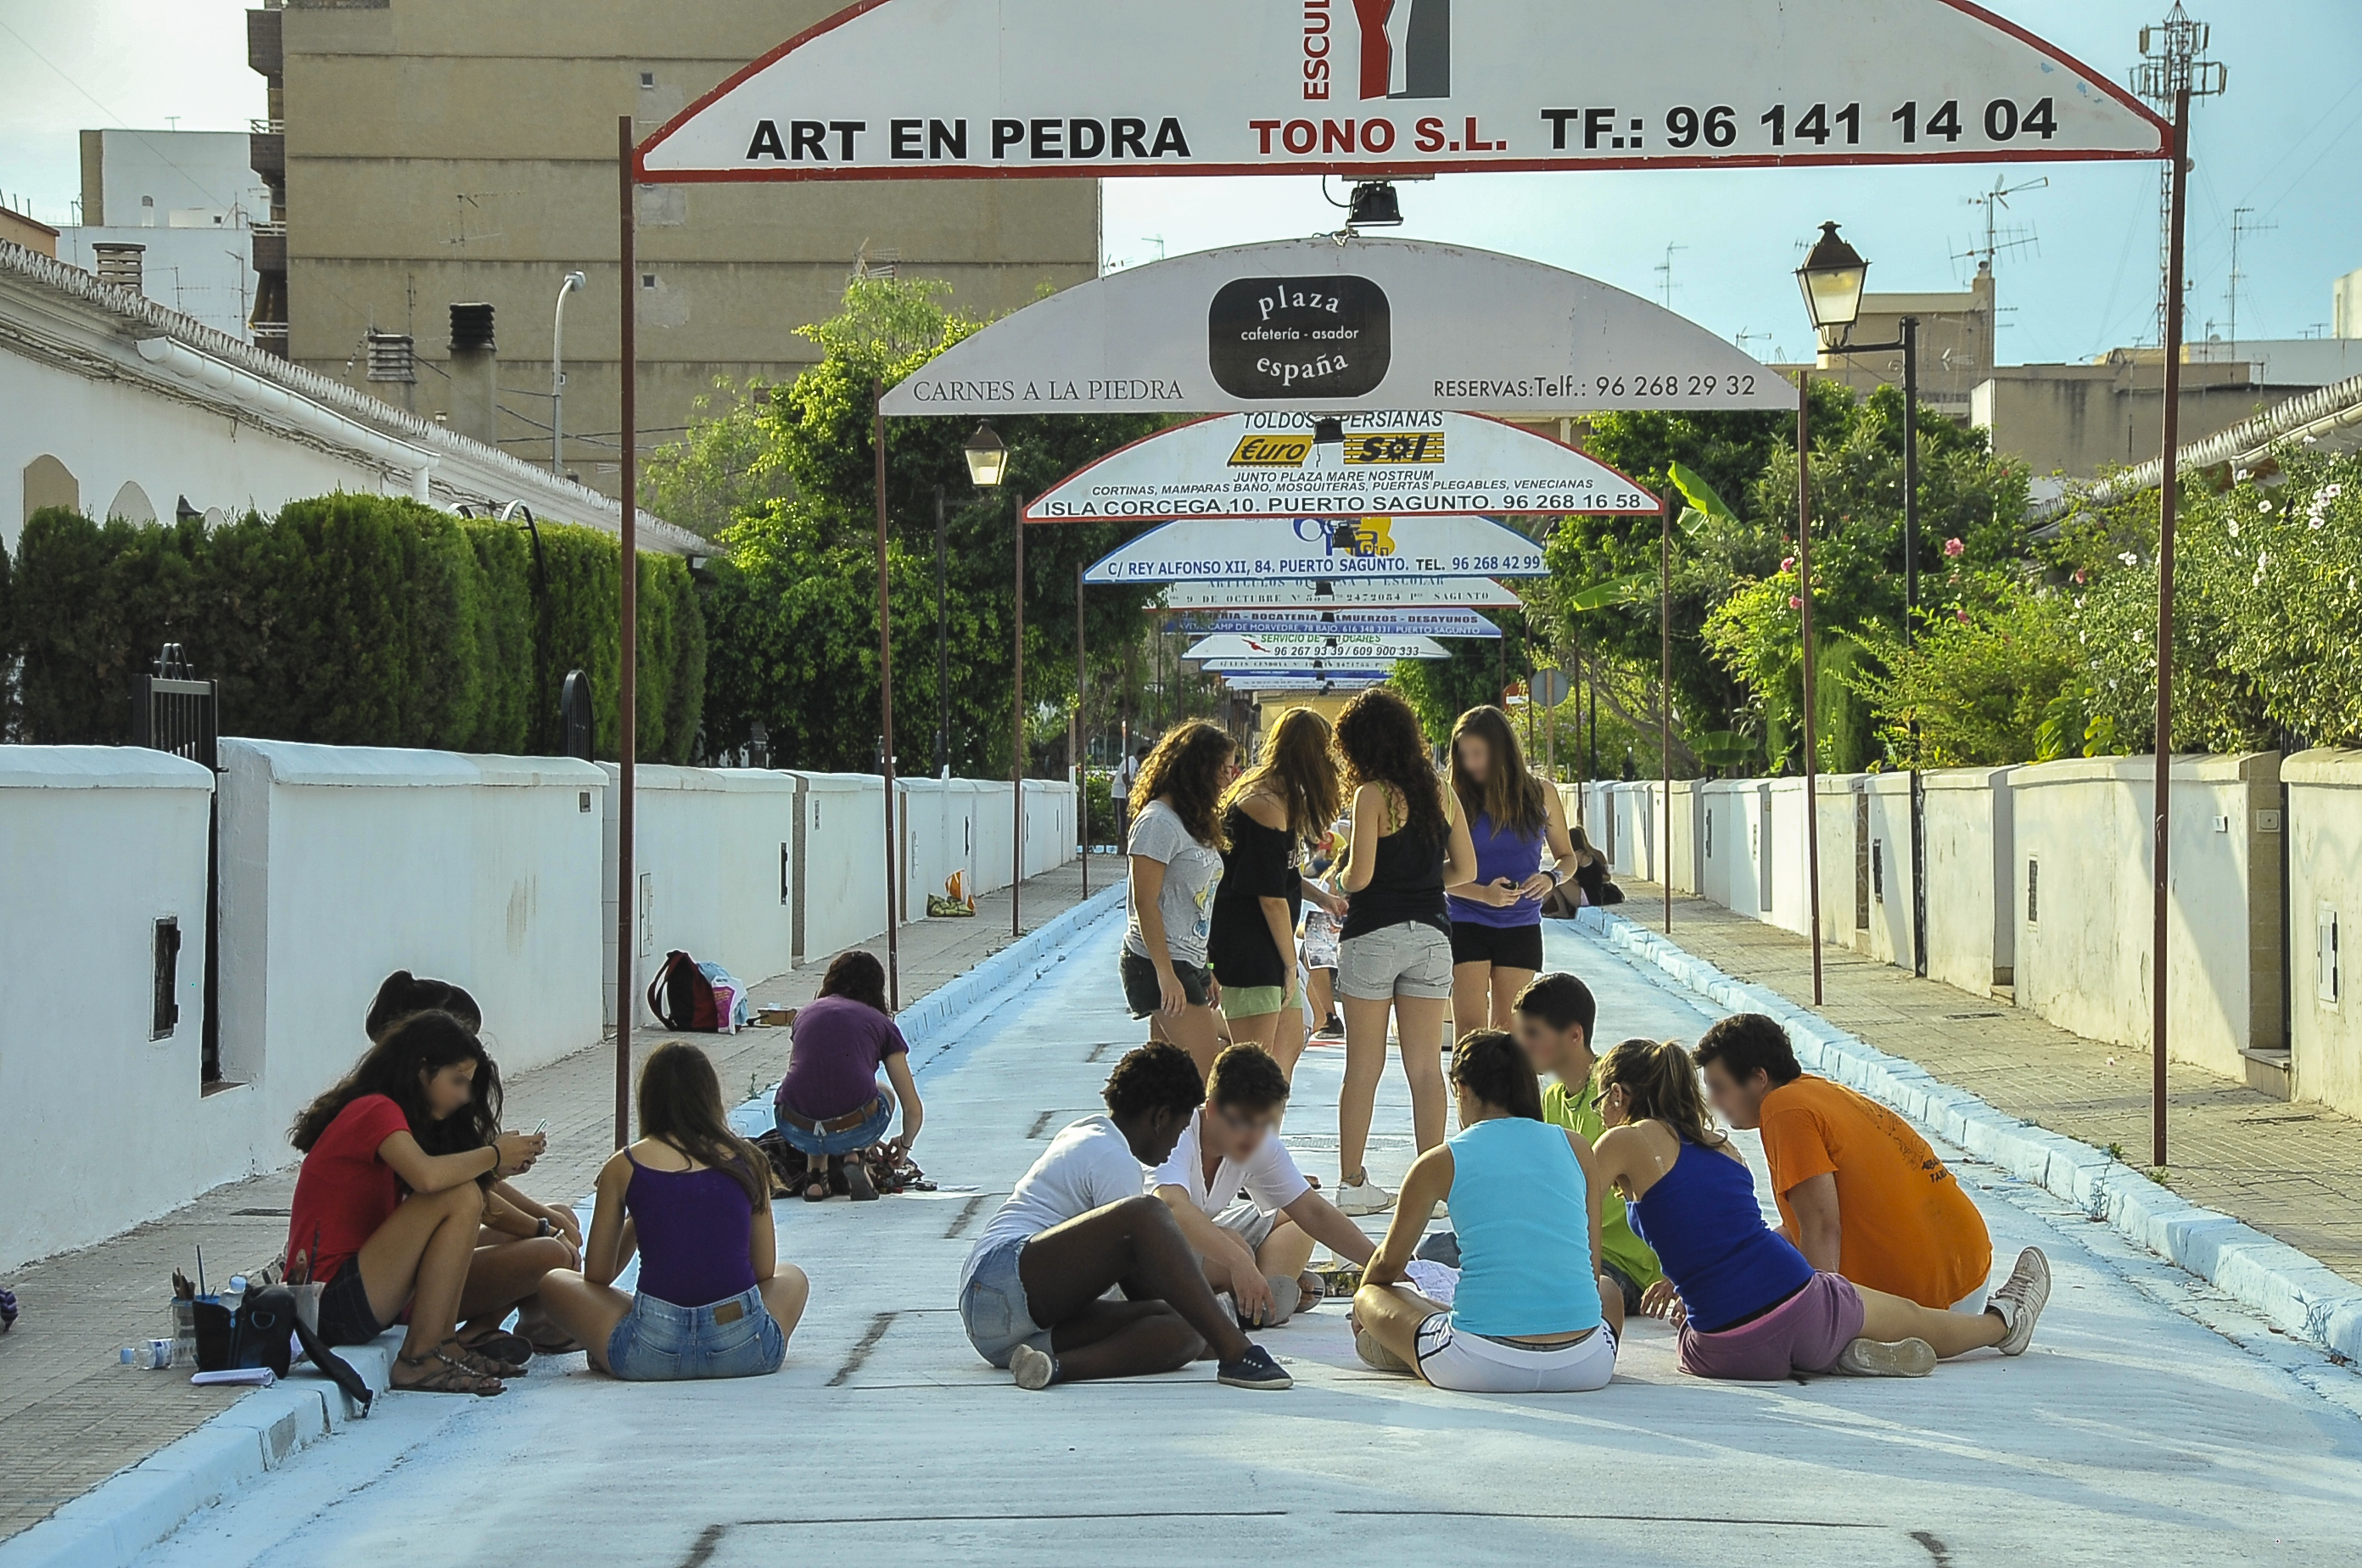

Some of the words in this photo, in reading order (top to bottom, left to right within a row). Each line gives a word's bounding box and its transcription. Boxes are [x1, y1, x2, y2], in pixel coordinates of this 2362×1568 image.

[1540, 107, 1644, 149] TF.:
[1665, 105, 1737, 148] 96
[1760, 103, 1861, 146] 141
[1891, 99, 1962, 143] 14
[1984, 98, 2057, 141] 04
[746, 120, 865, 160] ART
[889, 119, 967, 159] EN
[991, 117, 1190, 159] PEDRA
[1249, 118, 1396, 154] TONO
[1413, 116, 1508, 152] S.L.
[1258, 284, 1340, 321] plaza
[1241, 326, 1300, 341] cafetería
[1312, 326, 1359, 339] asador
[1257, 353, 1349, 387] españa
[913, 379, 1015, 401] CARNES
[1022, 380, 1039, 400] A
[1048, 380, 1080, 400] LA
[1087, 378, 1184, 400] PIEDRA
[1596, 376, 1626, 397] 96
[1633, 375, 1678, 397] 268
[1688, 375, 1717, 397] 29
[1726, 374, 1755, 396] 32
[1244, 412, 1315, 428] TOLDOS
[1340, 411, 1442, 428] PERSIANAS
[1234, 472, 1276, 482] JUNTO
[1280, 472, 1322, 482] PLAZA
[1327, 471, 1364, 482] MARE
[1368, 470, 1434, 481] NOSTRUM
[1092, 485, 1157, 496] CORTINAS,
[1161, 484, 1230, 495] MAMPARAS
[1275, 483, 1369, 495] MOSQUITERAS,
[1373, 482, 1429, 492] PUERTAS
[1432, 480, 1509, 491] PLEGABLES,
[1514, 479, 1593, 489] VENECIANAS
[1044, 501, 1097, 516] ISLA
[1268, 497, 1364, 512] PUERTO
[1373, 495, 1495, 511] SAGUNTO.
[1503, 495, 1529, 509] 96
[1536, 495, 1575, 509] 268
[1583, 494, 1608, 508] 16
[1615, 494, 1641, 508] 58
[1107, 563, 1122, 577] C/
[1128, 563, 1155, 575] REY
[1158, 561, 1221, 574] ALFONSO
[1225, 560, 1251, 576] XII,
[1254, 560, 1275, 574] 84.
[1280, 558, 1334, 573] PUERTO
[1339, 557, 1409, 572] SAGUNTO.
[1415, 559, 1446, 571] TEL.
[1452, 557, 1469, 570] 96
[1474, 557, 1498, 570] 268
[1503, 556, 1520, 569] 42
[1524, 555, 1540, 569] 99
[1203, 595, 1217, 603] DE
[1226, 594, 1281, 603] OCTUBRE
[1434, 592, 1489, 601] SAGUNTO
[1251, 613, 1318, 621] BOCATERIA
[1335, 614, 1396, 623] LMUERZOS
[1408, 615, 1478, 624] DESAYUNOS
[1261, 634, 1304, 643] SERVICIO
[1307, 635, 1320, 643] DE
[1434, 626, 1480, 635] SAGUNTO
[1274, 647, 1287, 656] 96
[1290, 647, 1311, 656] 267
[1314, 647, 1327, 656] 93
[1331, 647, 1344, 656] 39
[1353, 646, 1372, 656] 609
[1376, 646, 1396, 656] 900
[1399, 646, 1419, 656] 333
